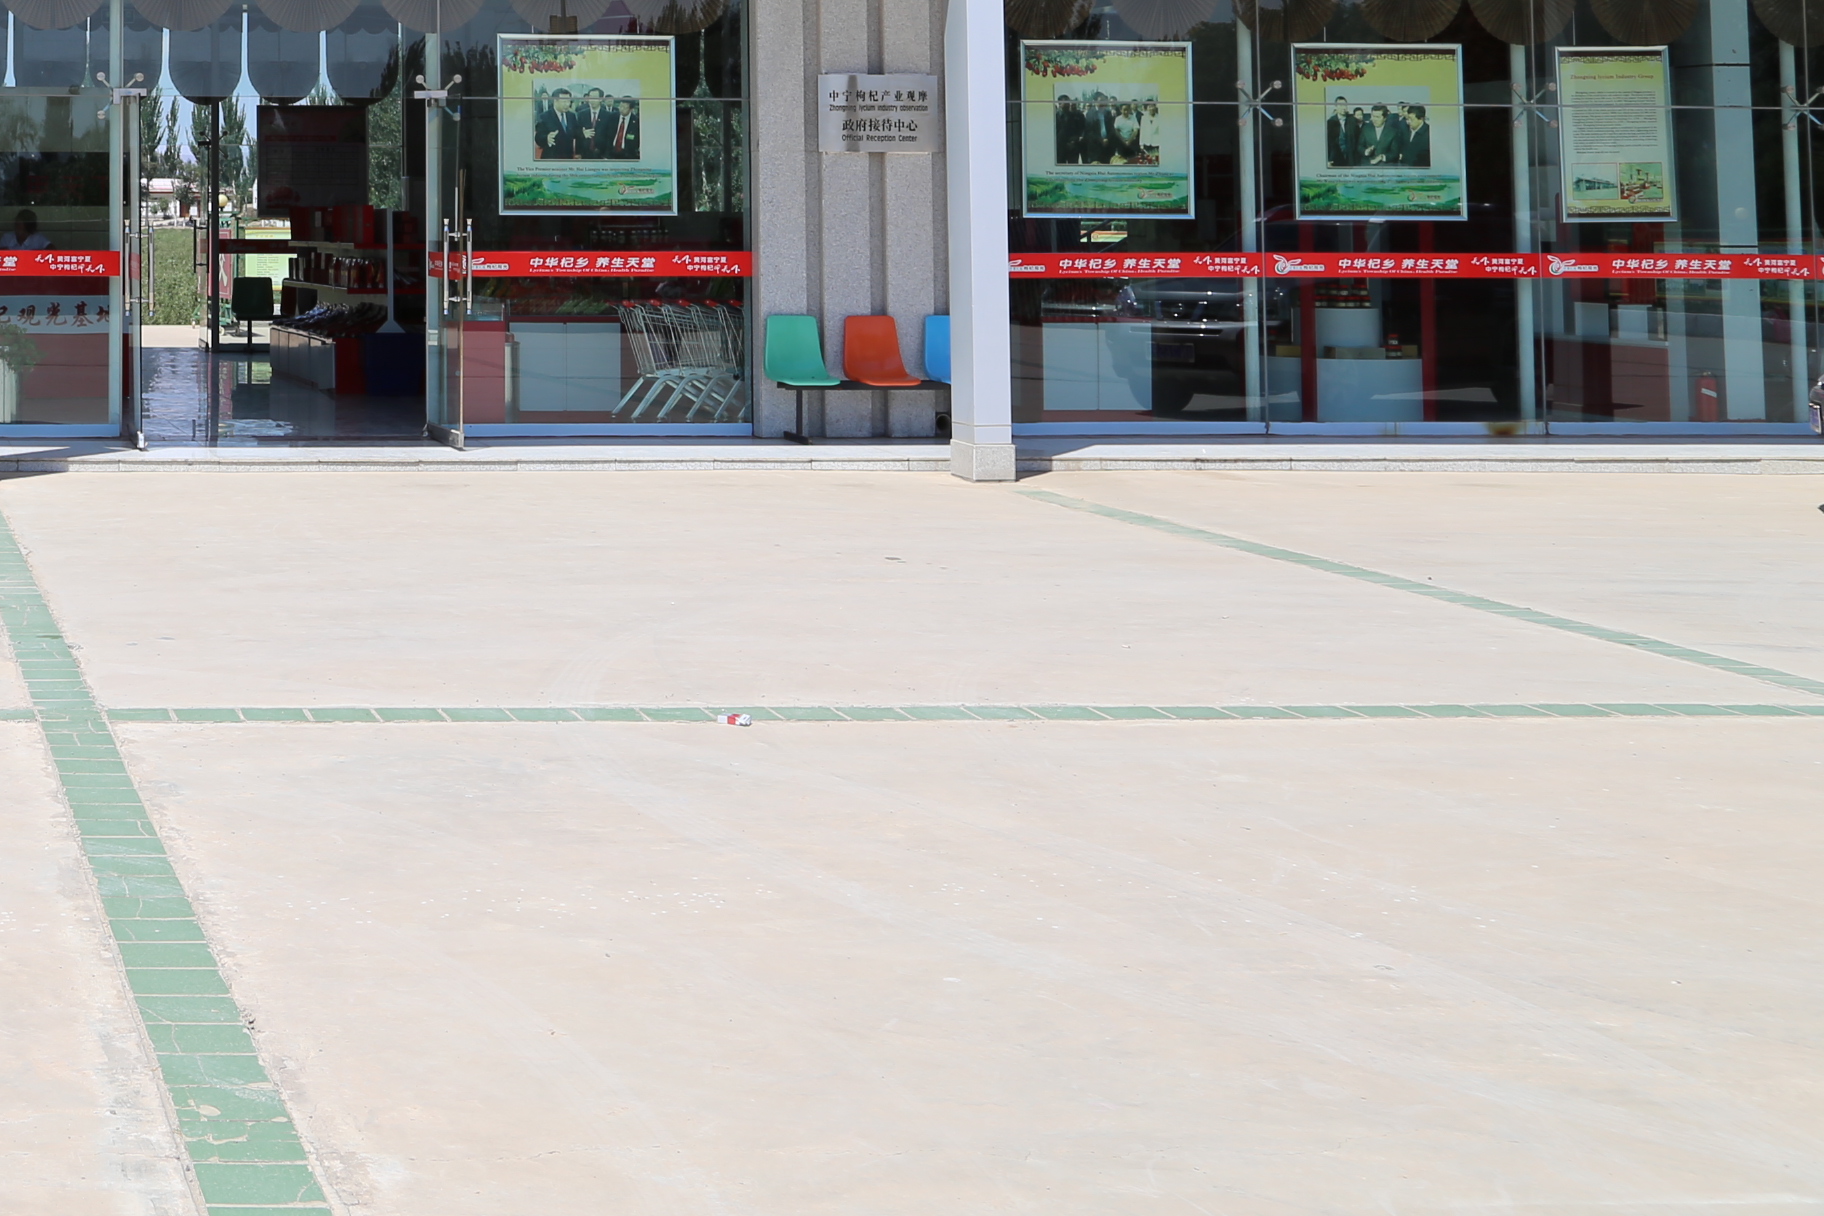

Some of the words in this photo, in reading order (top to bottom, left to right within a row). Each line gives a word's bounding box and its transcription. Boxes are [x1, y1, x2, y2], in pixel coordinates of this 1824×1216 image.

[829, 90, 928, 102] 中宁枸杞产业观摩
[829, 104, 856, 112] Zhongning
[877, 104, 898, 112] industry
[899, 104, 928, 112] observation
[842, 118, 918, 132] 政府接待中心
[841, 134, 864, 142] Official
[866, 134, 896, 142] Reception
[899, 134, 917, 142] Center
[530, 256, 590, 268] 中华杞乡
[595, 256, 656, 269] 养生天堂
[1059, 258, 1118, 269] 中华杞乡
[1124, 258, 1182, 270] 养生天堂
[1338, 258, 1396, 269] 中华杞乡
[1402, 258, 1460, 270] 养生天堂
[1612, 258, 1669, 270] 中华杞乡
[1675, 259, 1732, 270] 养生天堂
